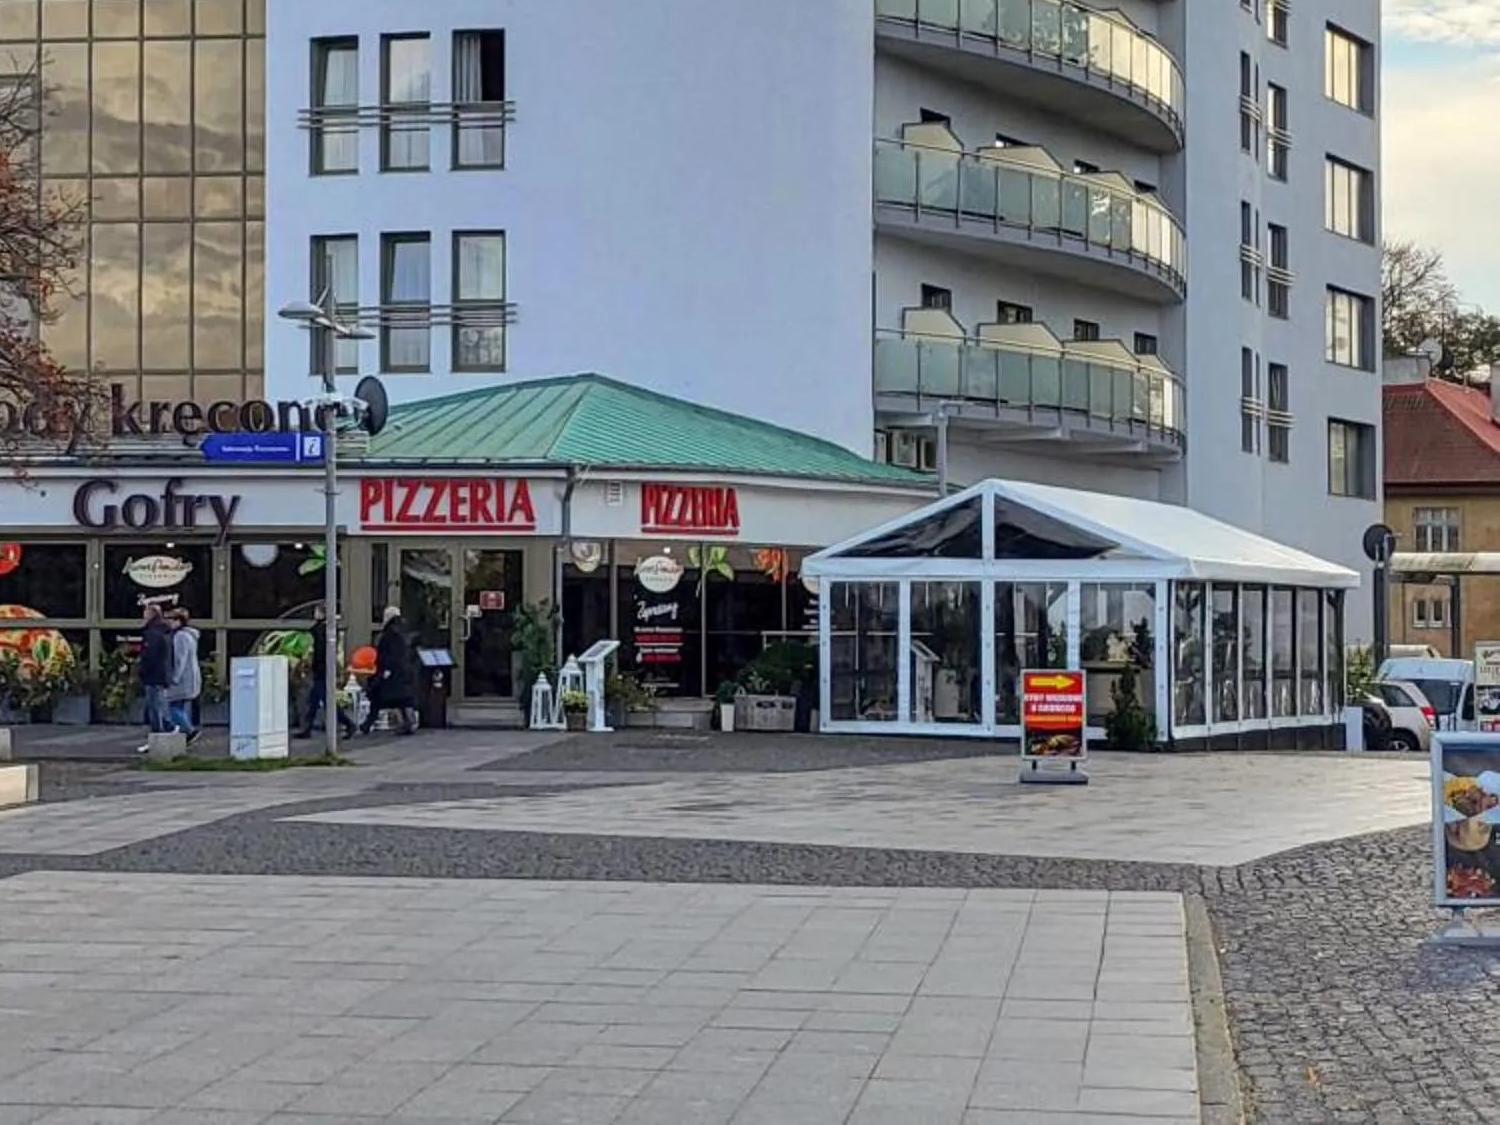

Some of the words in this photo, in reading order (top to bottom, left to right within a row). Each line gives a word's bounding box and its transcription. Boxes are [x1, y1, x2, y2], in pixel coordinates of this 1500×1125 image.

[73, 476, 242, 547] Gofry
[360, 477, 536, 523] PIZZERIA
[641, 481, 740, 528] PIZZERIA
